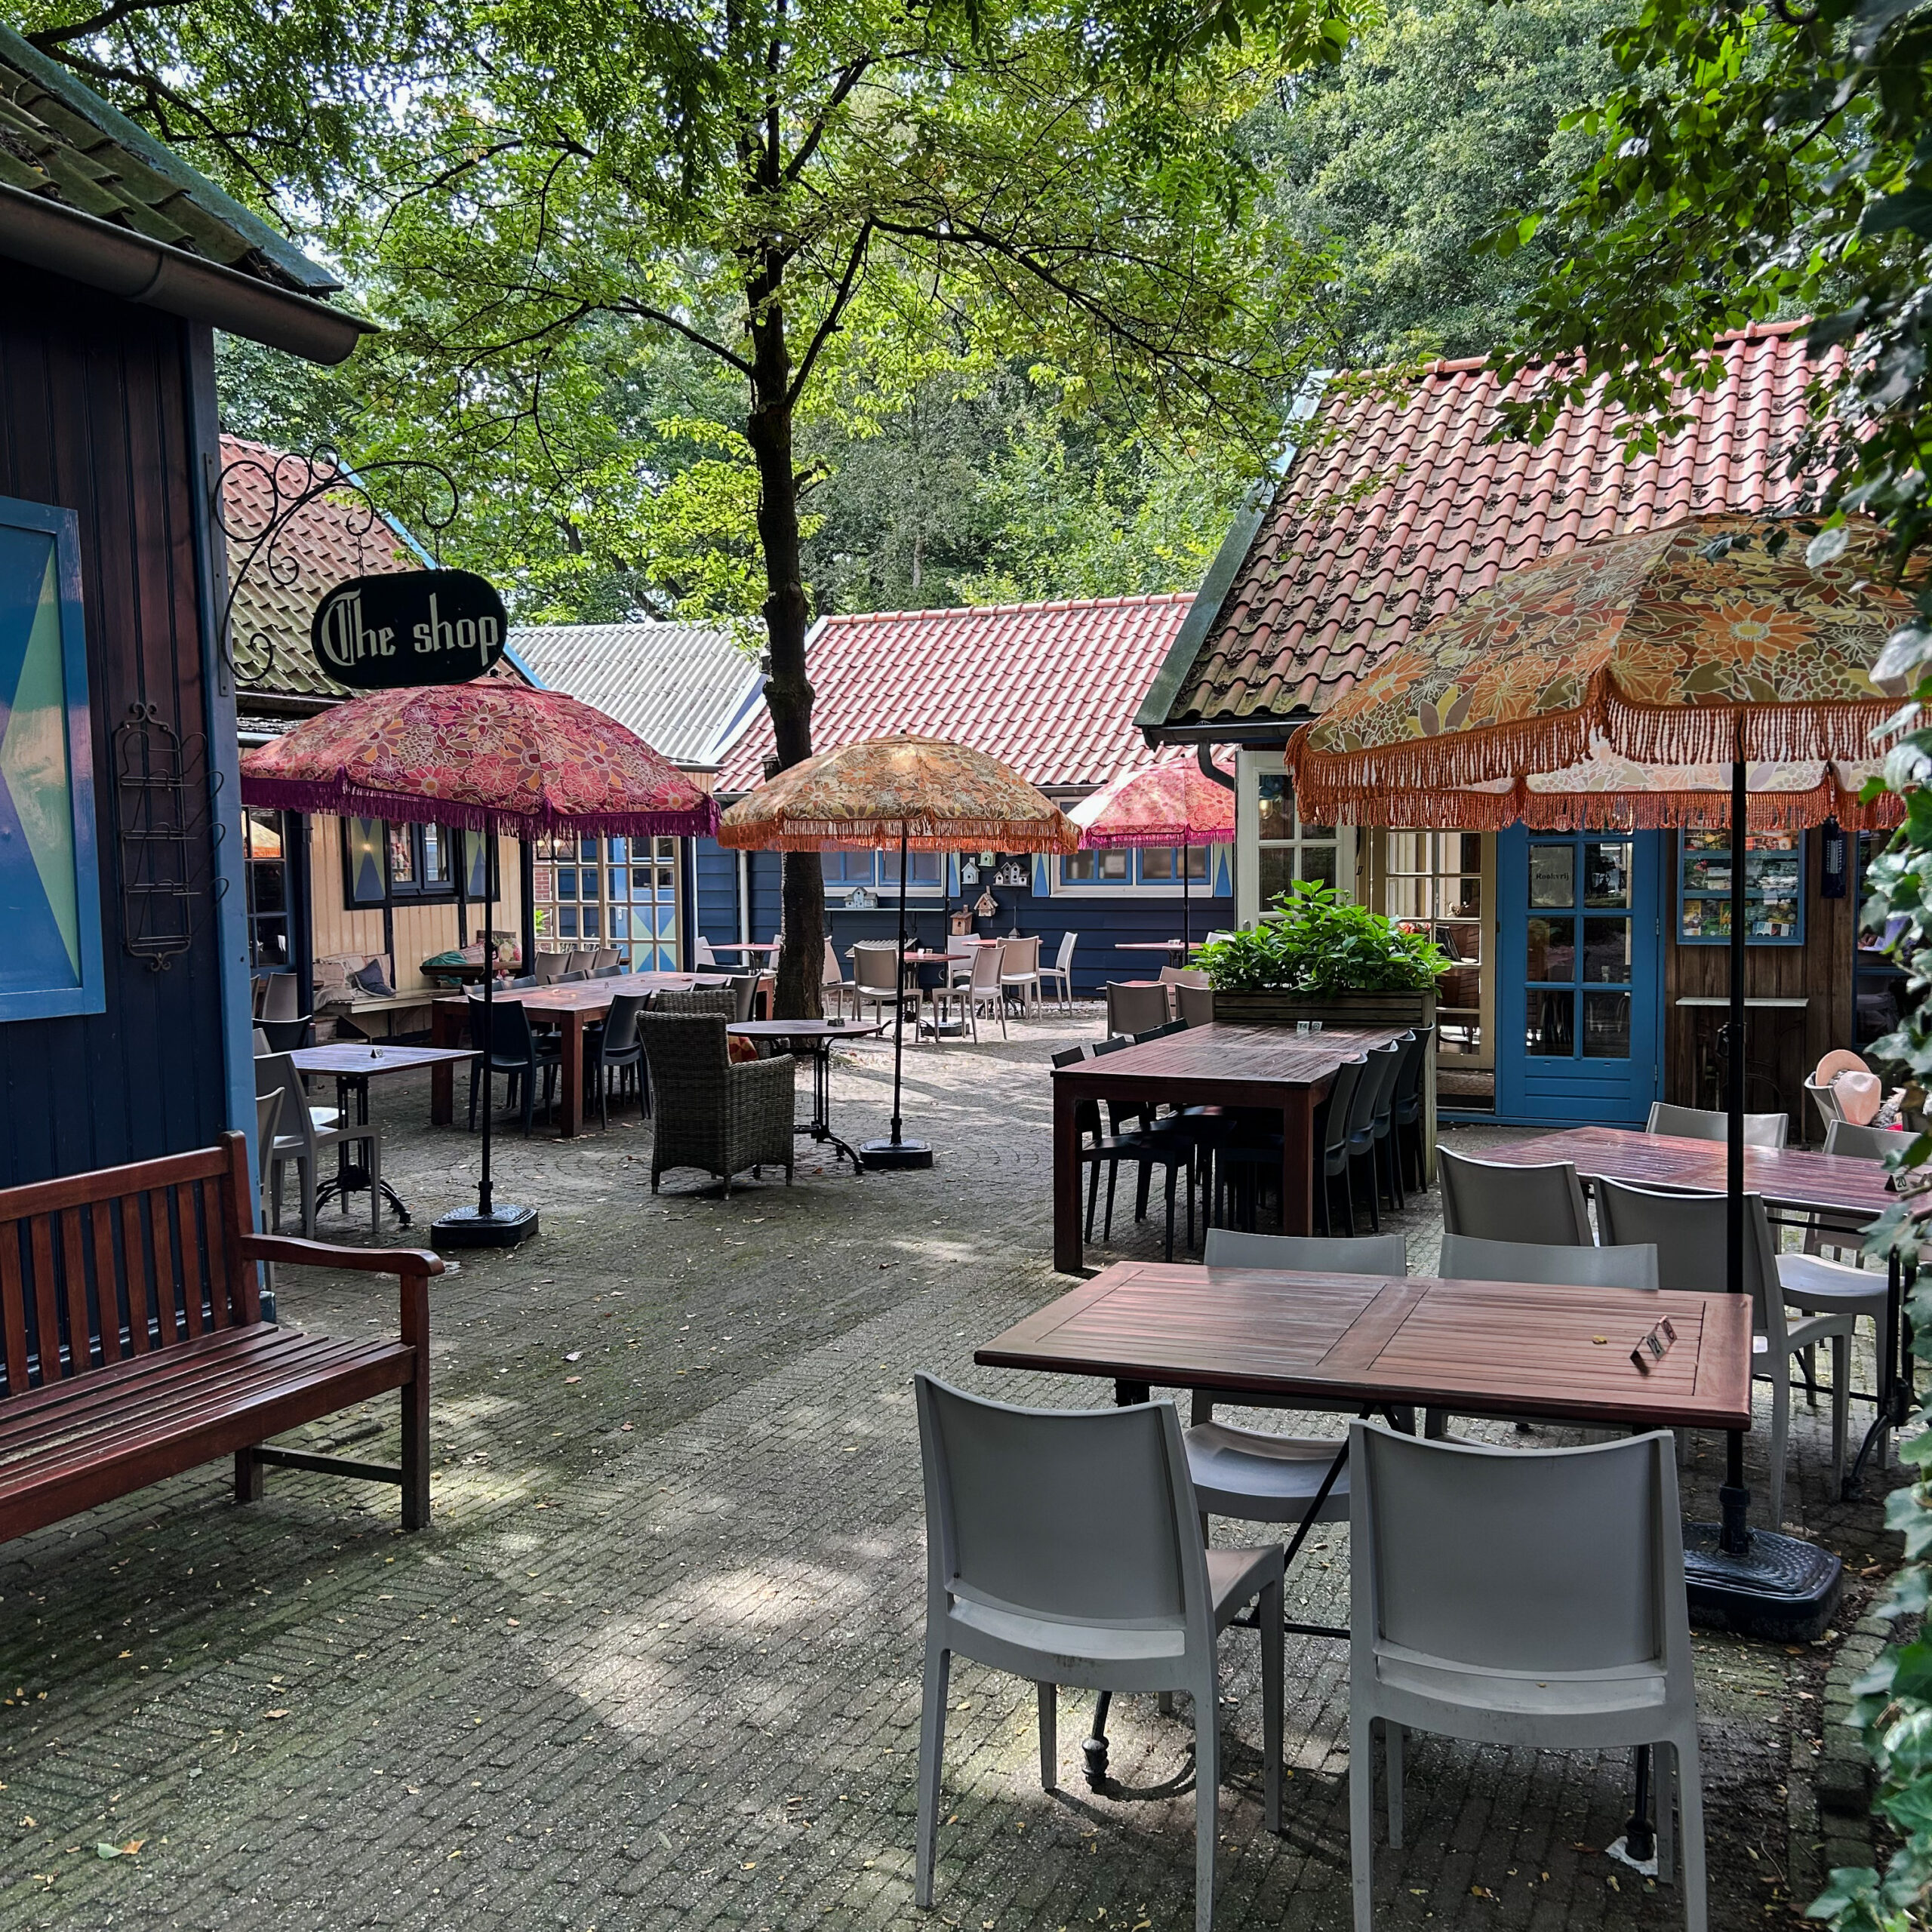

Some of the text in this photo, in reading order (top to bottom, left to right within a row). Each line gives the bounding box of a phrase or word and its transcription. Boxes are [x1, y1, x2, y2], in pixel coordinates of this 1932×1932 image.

[321, 588, 498, 667] The shop
[1536, 872, 1569, 881] Rookvrij
[1896, 1177, 1907, 1188] 20
